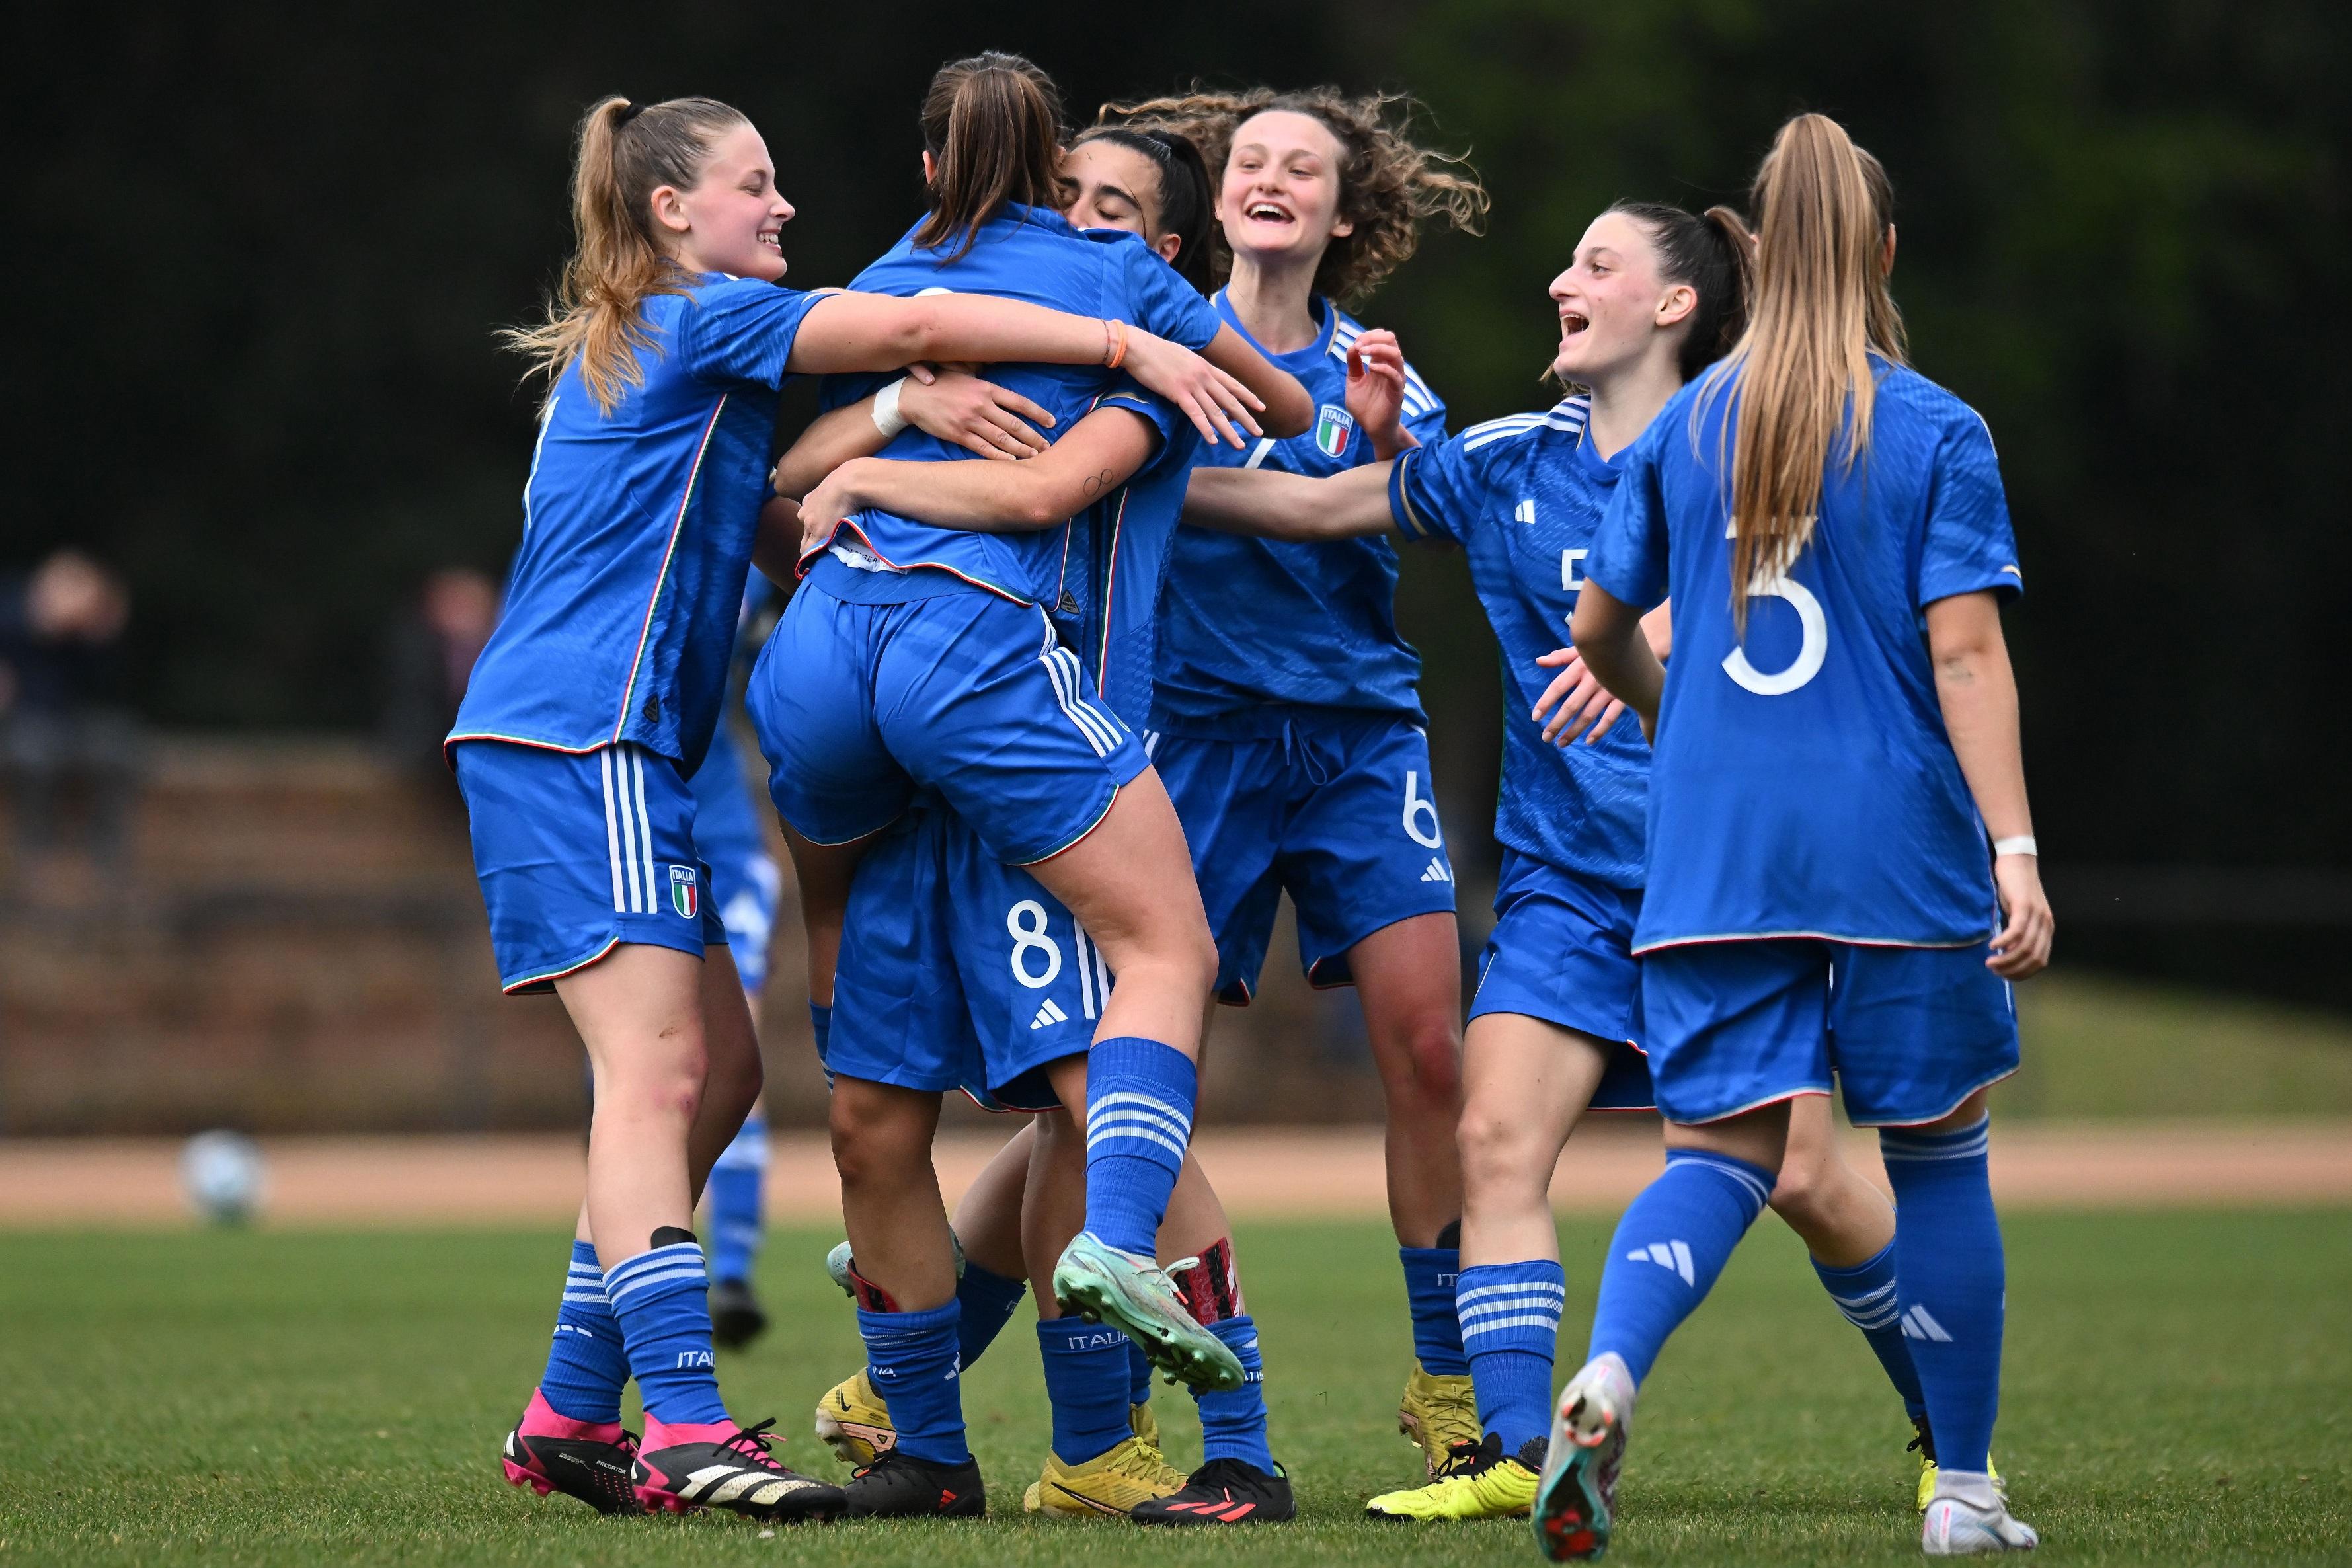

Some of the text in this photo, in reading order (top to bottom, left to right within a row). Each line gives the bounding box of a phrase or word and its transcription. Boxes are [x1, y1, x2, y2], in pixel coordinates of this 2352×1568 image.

[1323, 409, 1350, 427] ITALIA
[1721, 516, 1828, 695] 3
[1403, 771, 1441, 849] 6
[672, 869, 694, 882] ITALIA
[1007, 900, 1062, 988] 8
[596, 1460, 627, 1475] PREDATOR
